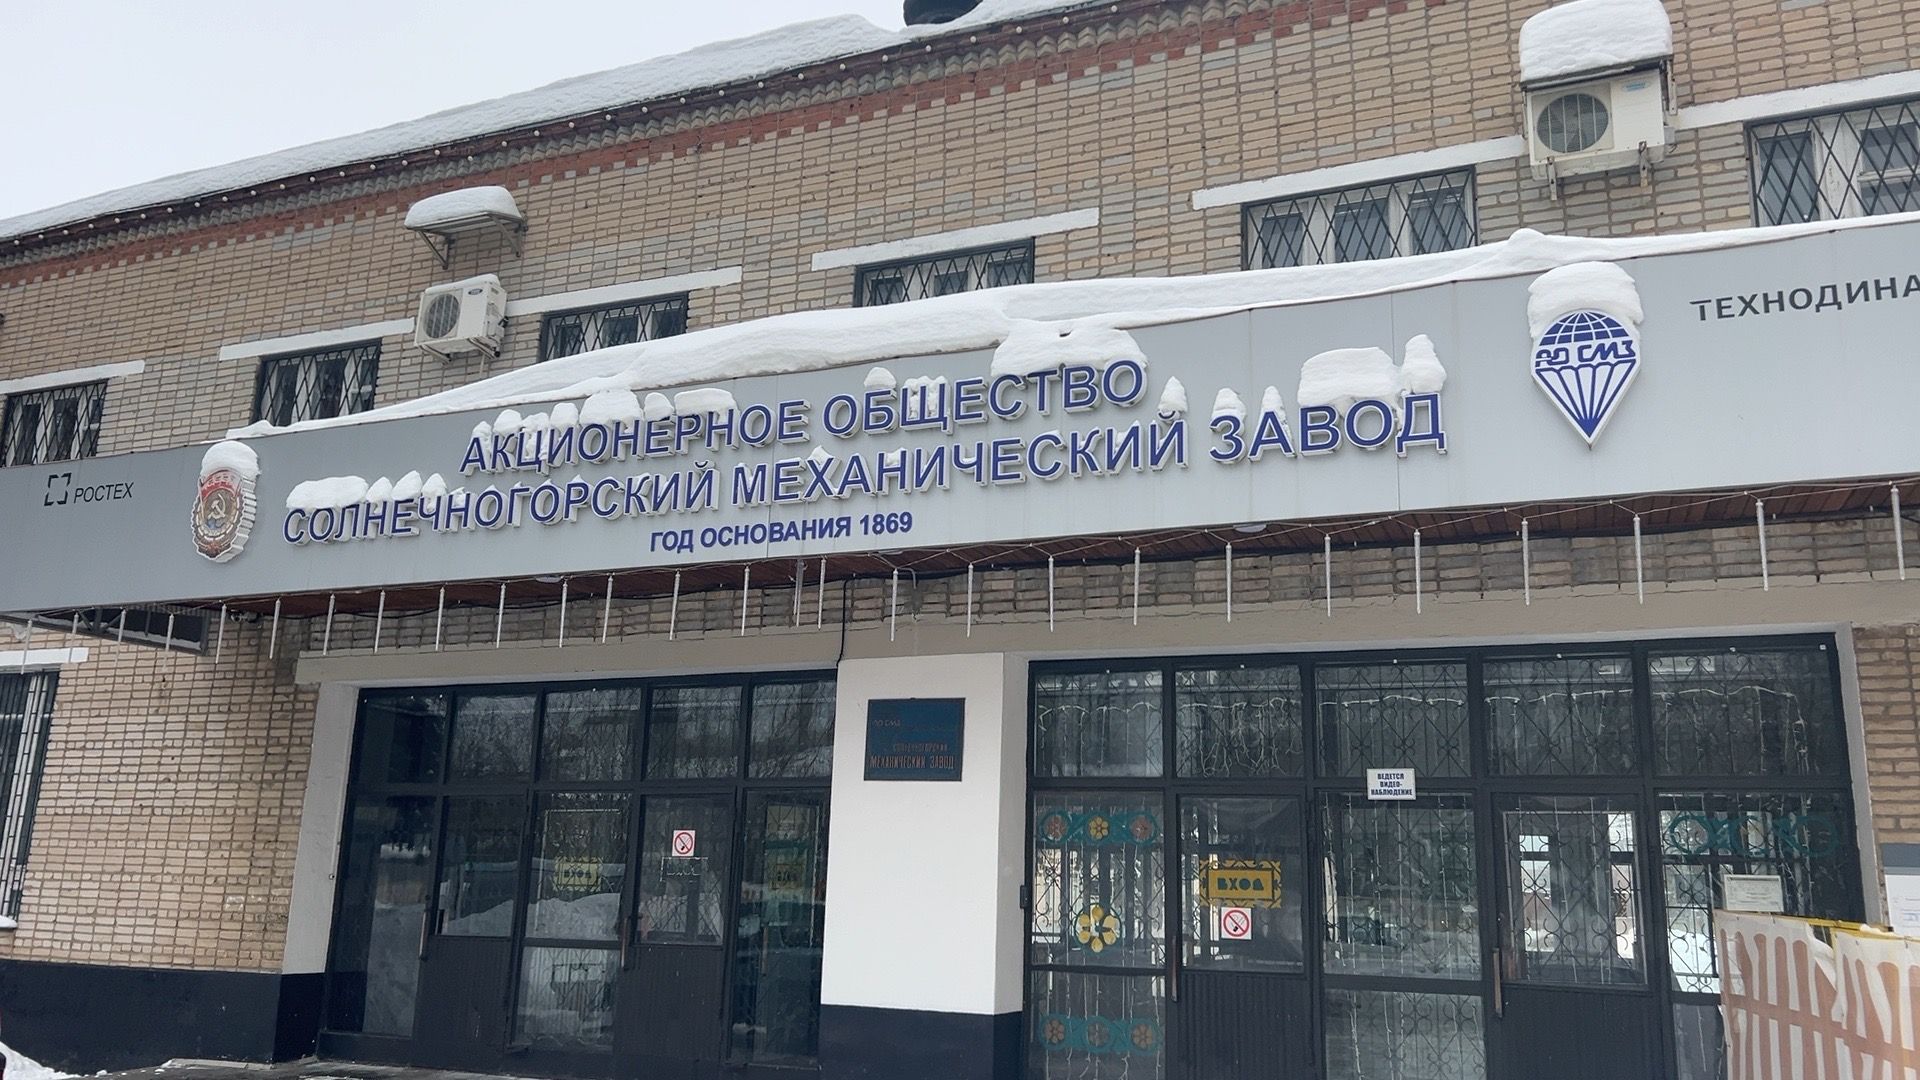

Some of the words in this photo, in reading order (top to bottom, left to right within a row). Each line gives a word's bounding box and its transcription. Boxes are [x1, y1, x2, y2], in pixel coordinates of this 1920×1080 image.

[1577, 340, 1636, 362] СМЗ
[461, 398, 809, 475] АКЦИОНЕРНОЕ
[823, 359, 1147, 435] ОБЩЕСТВО
[283, 460, 716, 543] СОЛНЕЧНОГОРСКИЙ
[732, 408, 1187, 504] МЕХАНИЧЕСКИЙ
[1209, 393, 1447, 462] ЗАВОД
[74, 481, 134, 504] РОСТЕХ
[650, 530, 694, 553] ГОД
[700, 517, 851, 547] ОСНОВАНИЯ
[859, 511, 913, 535] 1869
[1217, 878, 1264, 890] ВХОД
